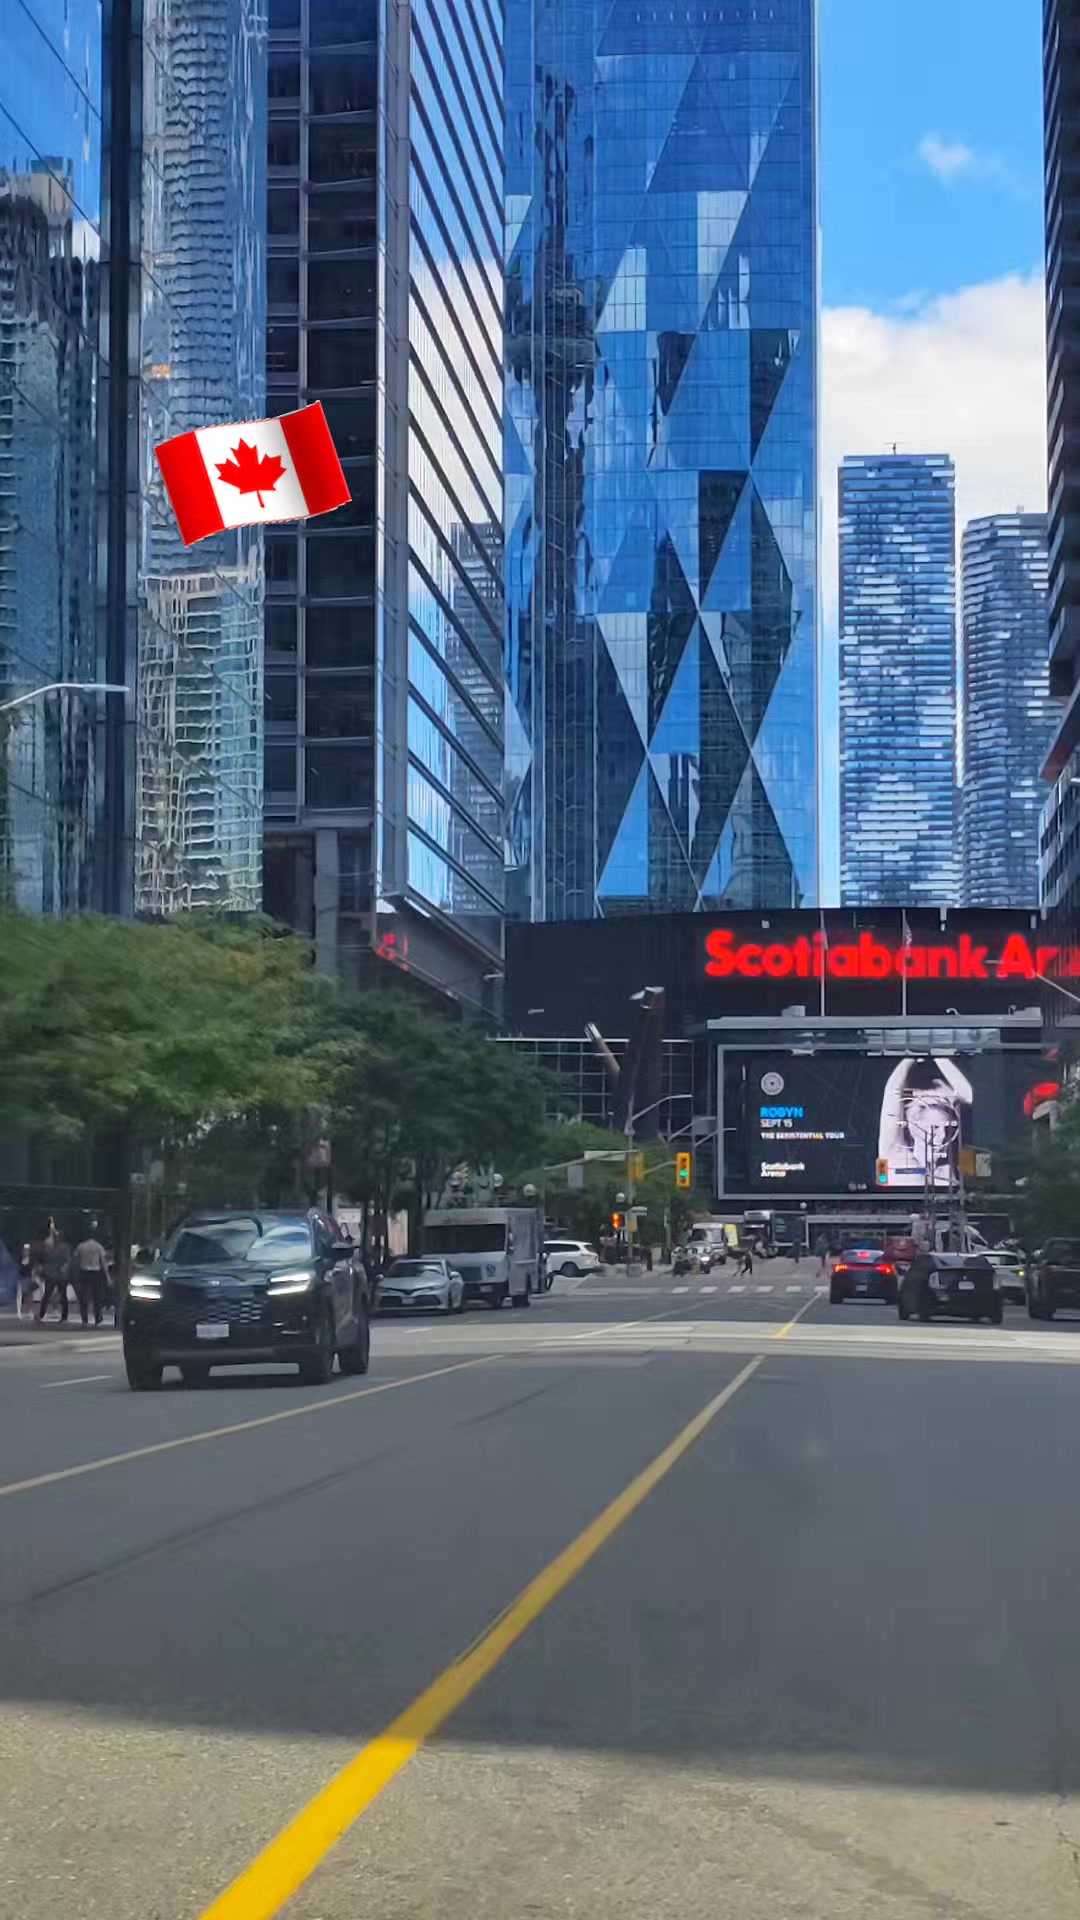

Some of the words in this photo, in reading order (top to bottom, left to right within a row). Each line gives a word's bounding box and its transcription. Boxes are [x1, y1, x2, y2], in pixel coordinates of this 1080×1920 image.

[705, 929, 989, 979] Scotiabank
[760, 1106, 804, 1118] ROBYN
[760, 1119, 781, 1128] SEPT
